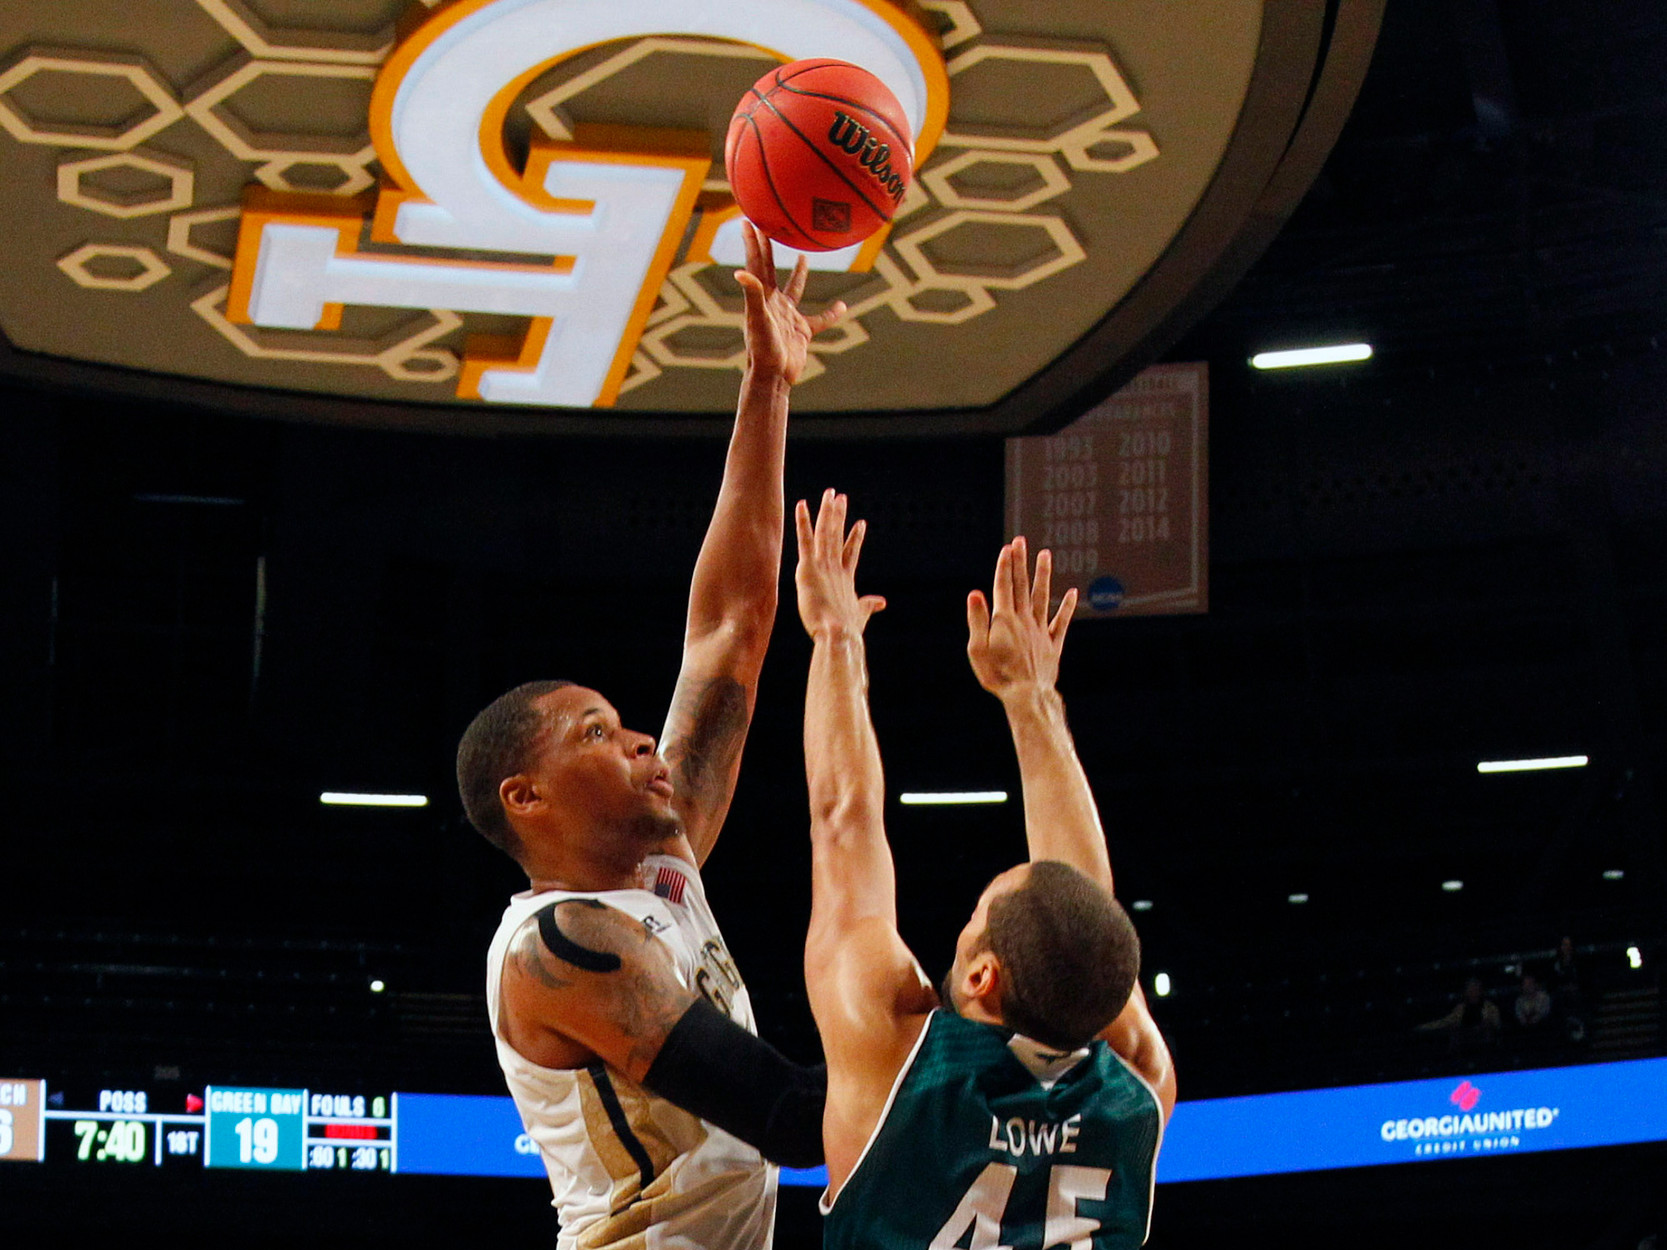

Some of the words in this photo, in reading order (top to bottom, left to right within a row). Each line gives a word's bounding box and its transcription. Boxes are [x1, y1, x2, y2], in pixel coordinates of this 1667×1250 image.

[828, 110, 907, 205] Wilson
[1118, 430, 1172, 457] 2010
[1118, 459, 1167, 486] 2011
[1118, 486, 1169, 514] 2012
[1117, 515, 1171, 544] 2014
[1052, 547, 1099, 575] 009
[0, 1082, 27, 1106] CH
[99, 1089, 147, 1114] POSS
[211, 1090, 267, 1114] GREEN
[270, 1092, 302, 1115] BAY
[311, 1093, 365, 1118] FOULS
[74, 1119, 147, 1162] 7:40
[234, 1116, 279, 1165] 19
[989, 1112, 1082, 1157] LOWE
[1414, 1139, 1467, 1156] CREDIT
[1473, 1135, 1521, 1151] UNION
